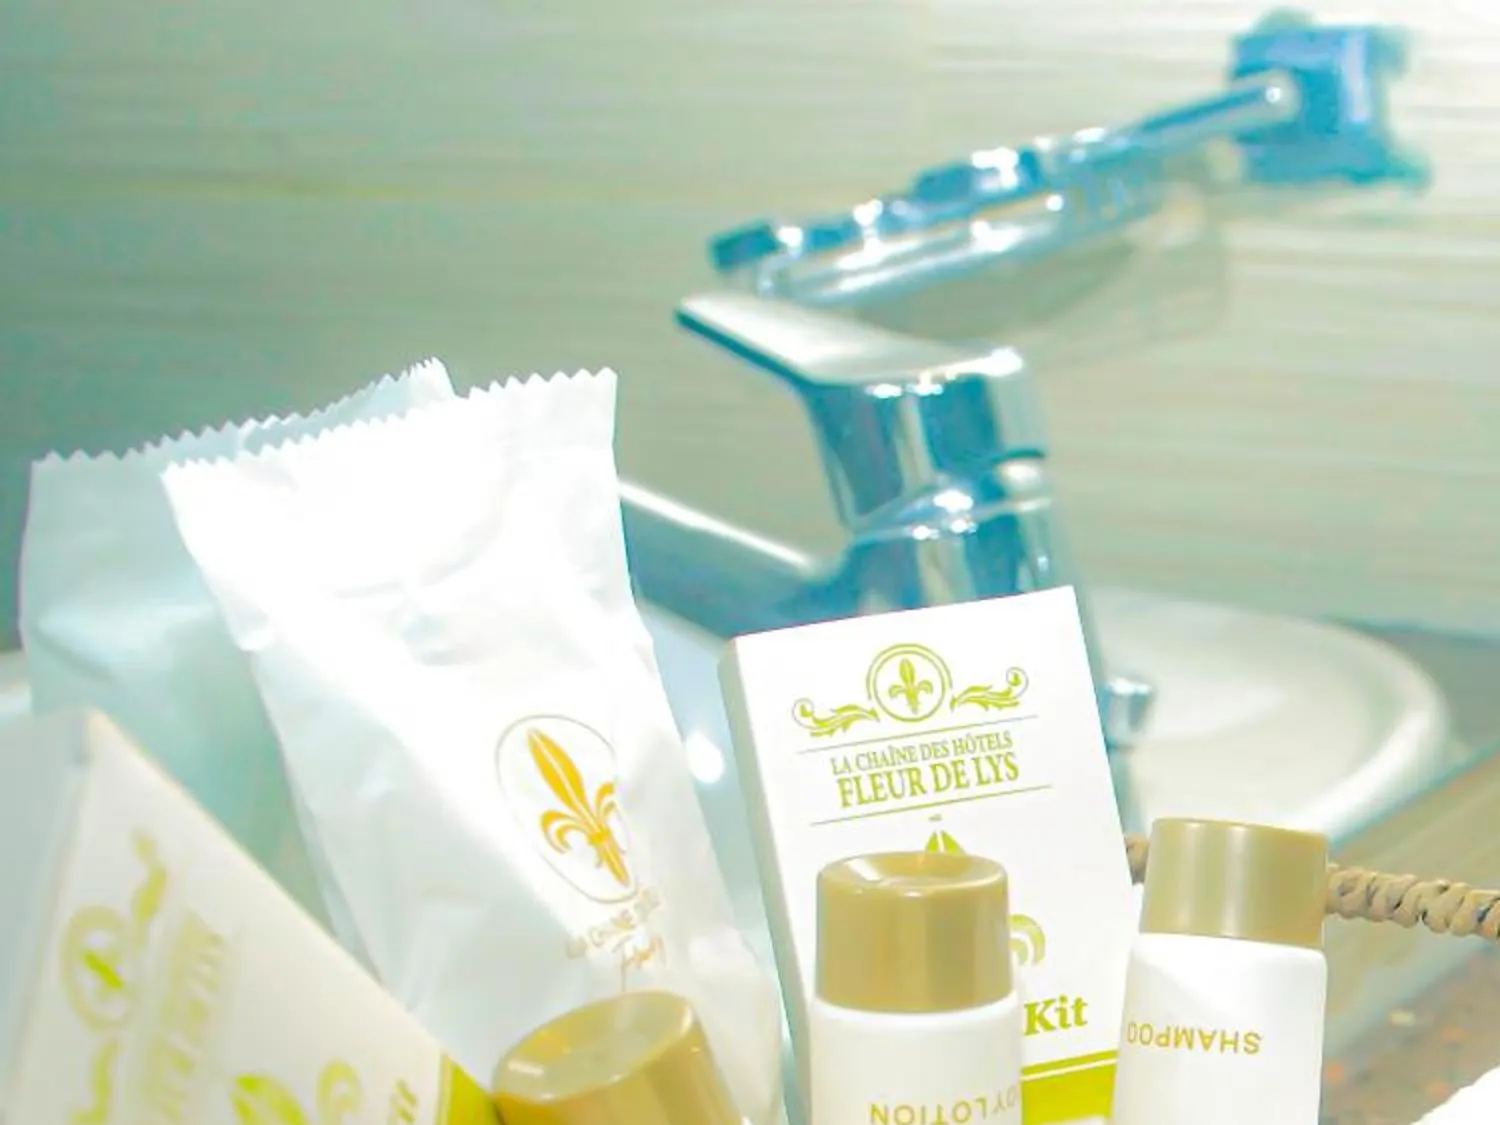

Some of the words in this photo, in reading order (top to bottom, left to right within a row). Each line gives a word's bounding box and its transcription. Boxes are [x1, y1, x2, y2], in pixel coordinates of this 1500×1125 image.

[829, 756, 855, 776] LA
[918, 740, 950, 762] DES
[951, 730, 1014, 757] HÔTELS
[836, 766, 927, 809] FLEUR
[929, 759, 970, 793] DE
[970, 751, 1020, 787] LYS
[1022, 994, 1089, 1036] Kit
[1126, 1021, 1263, 1055] SHAMPOO
